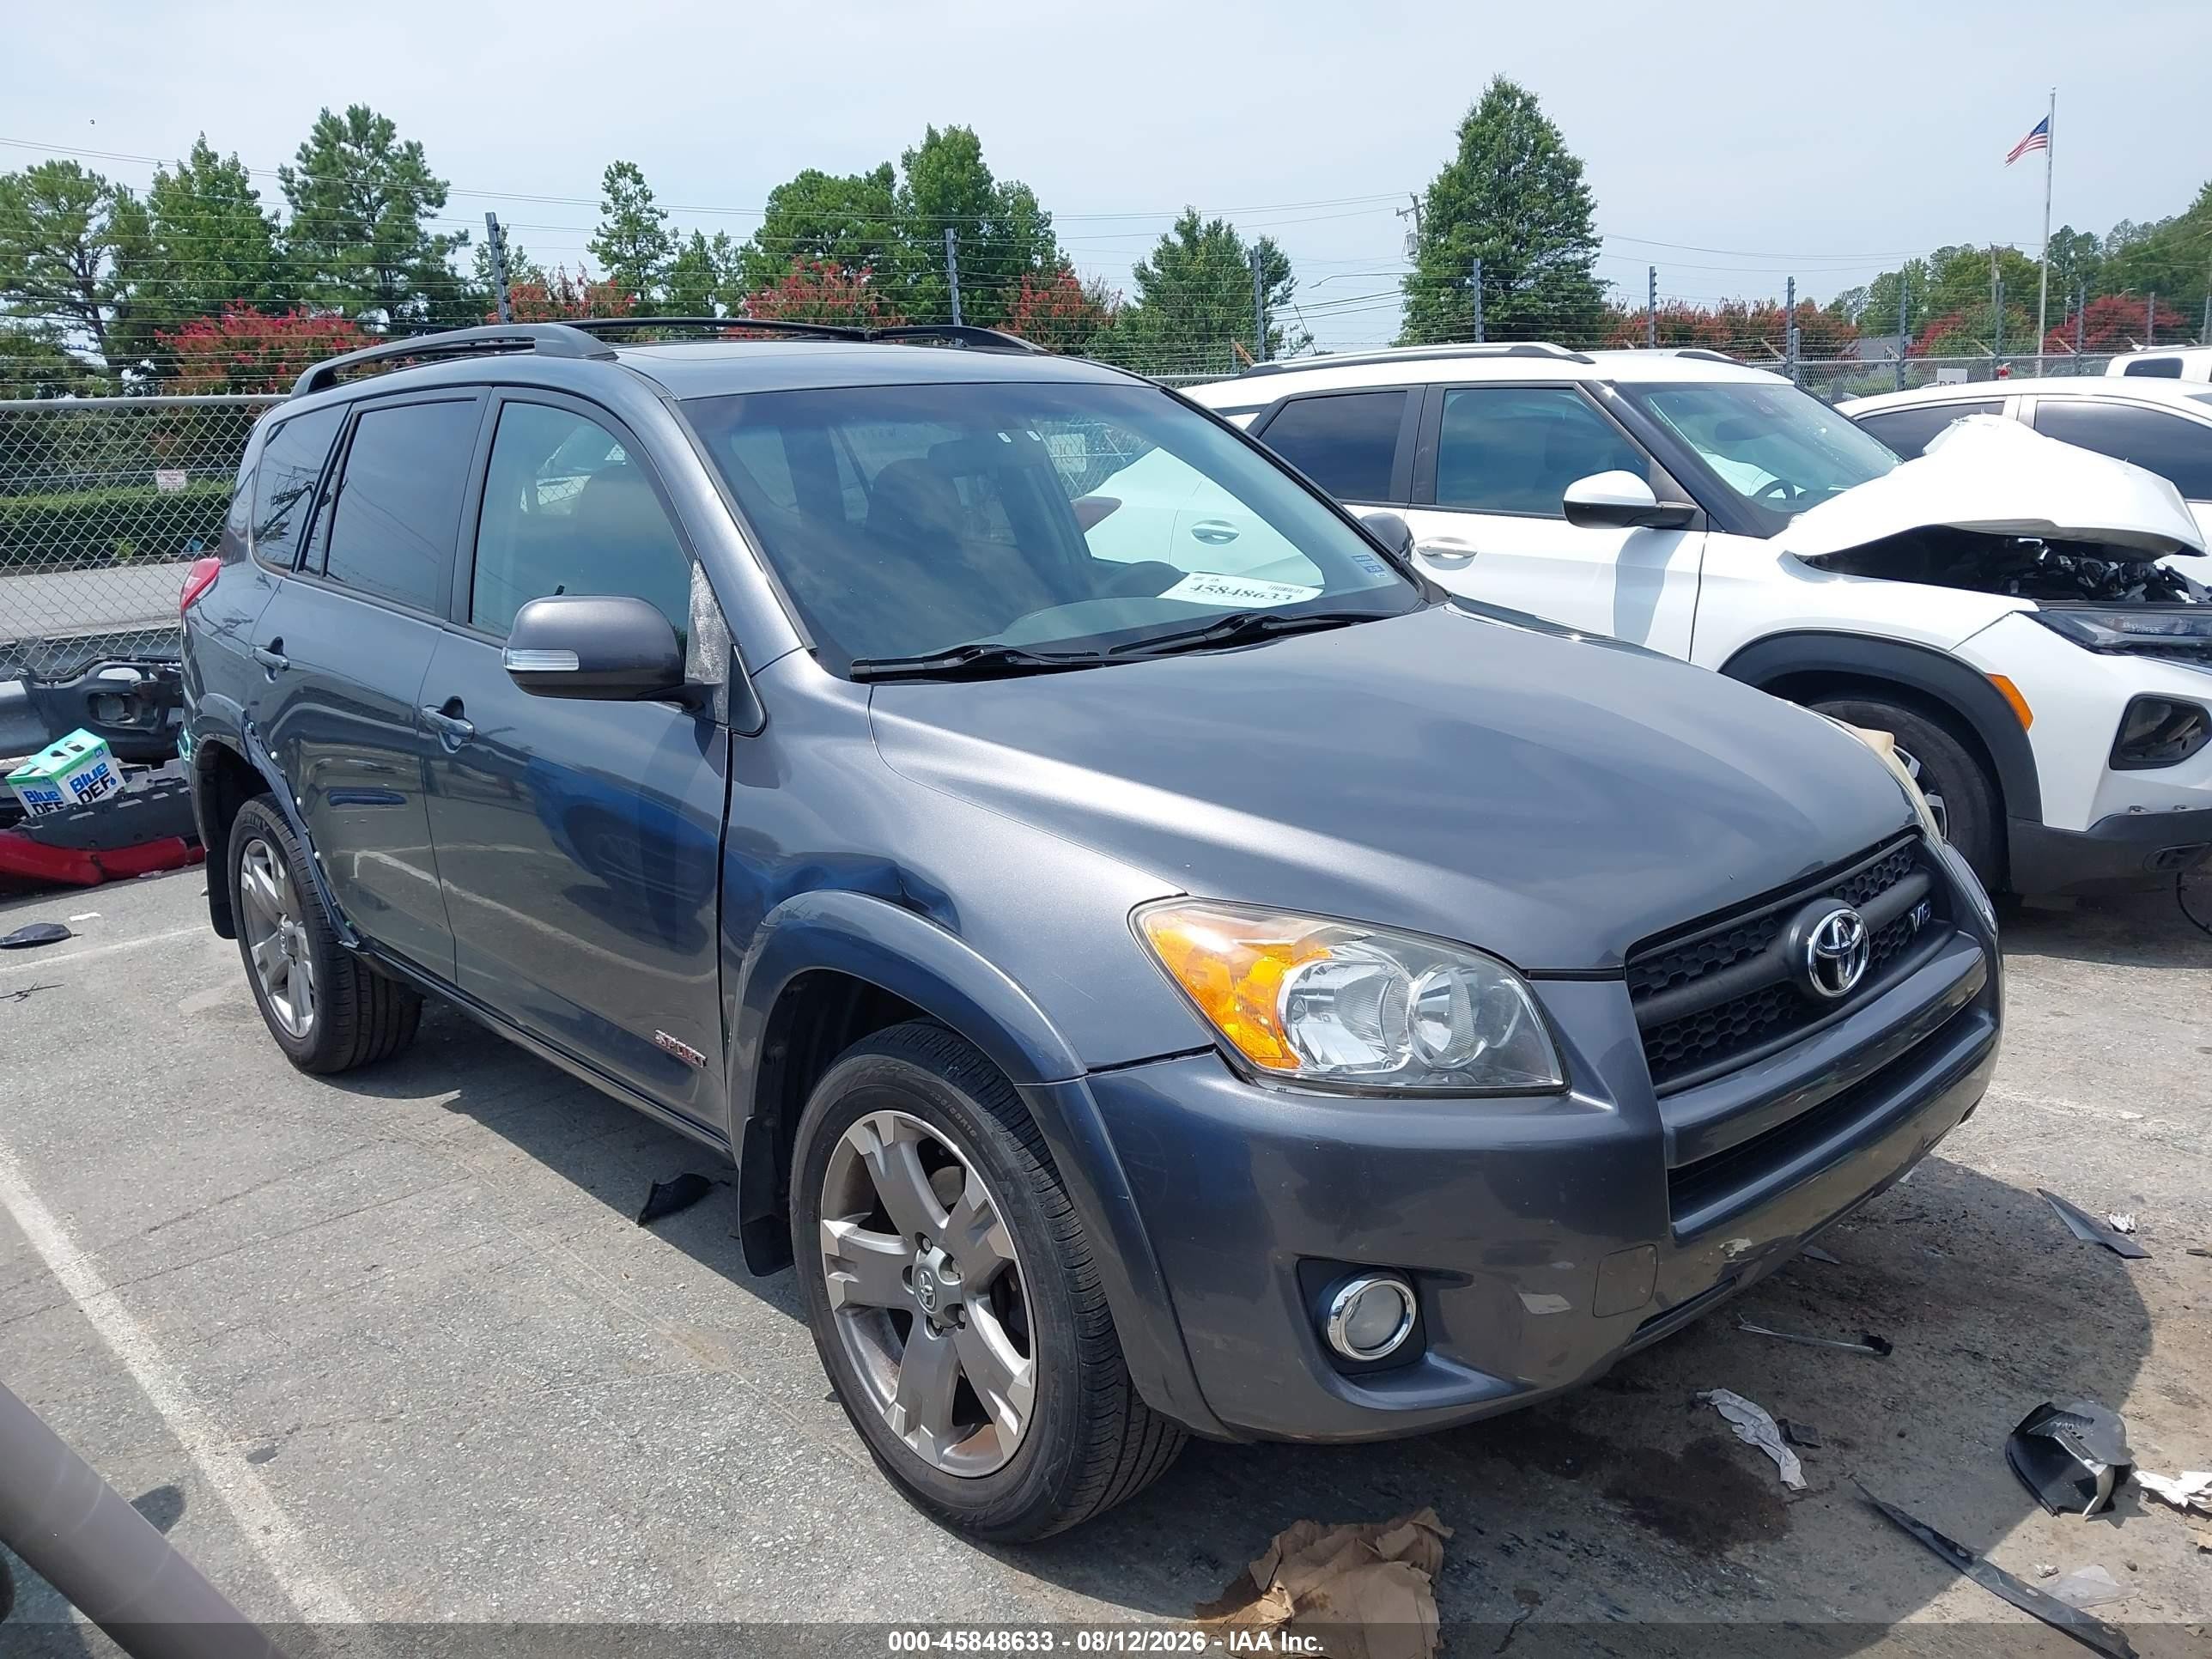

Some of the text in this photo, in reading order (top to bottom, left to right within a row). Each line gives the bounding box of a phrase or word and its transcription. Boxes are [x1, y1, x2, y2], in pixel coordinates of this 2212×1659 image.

[1189, 584, 1292, 601] 45848633
[69, 762, 108, 793] Blue
[77, 772, 111, 803] DEF
[22, 790, 61, 803] Blue
[1910, 899, 1931, 933] V6
[655, 1029, 707, 1068] SPORT
